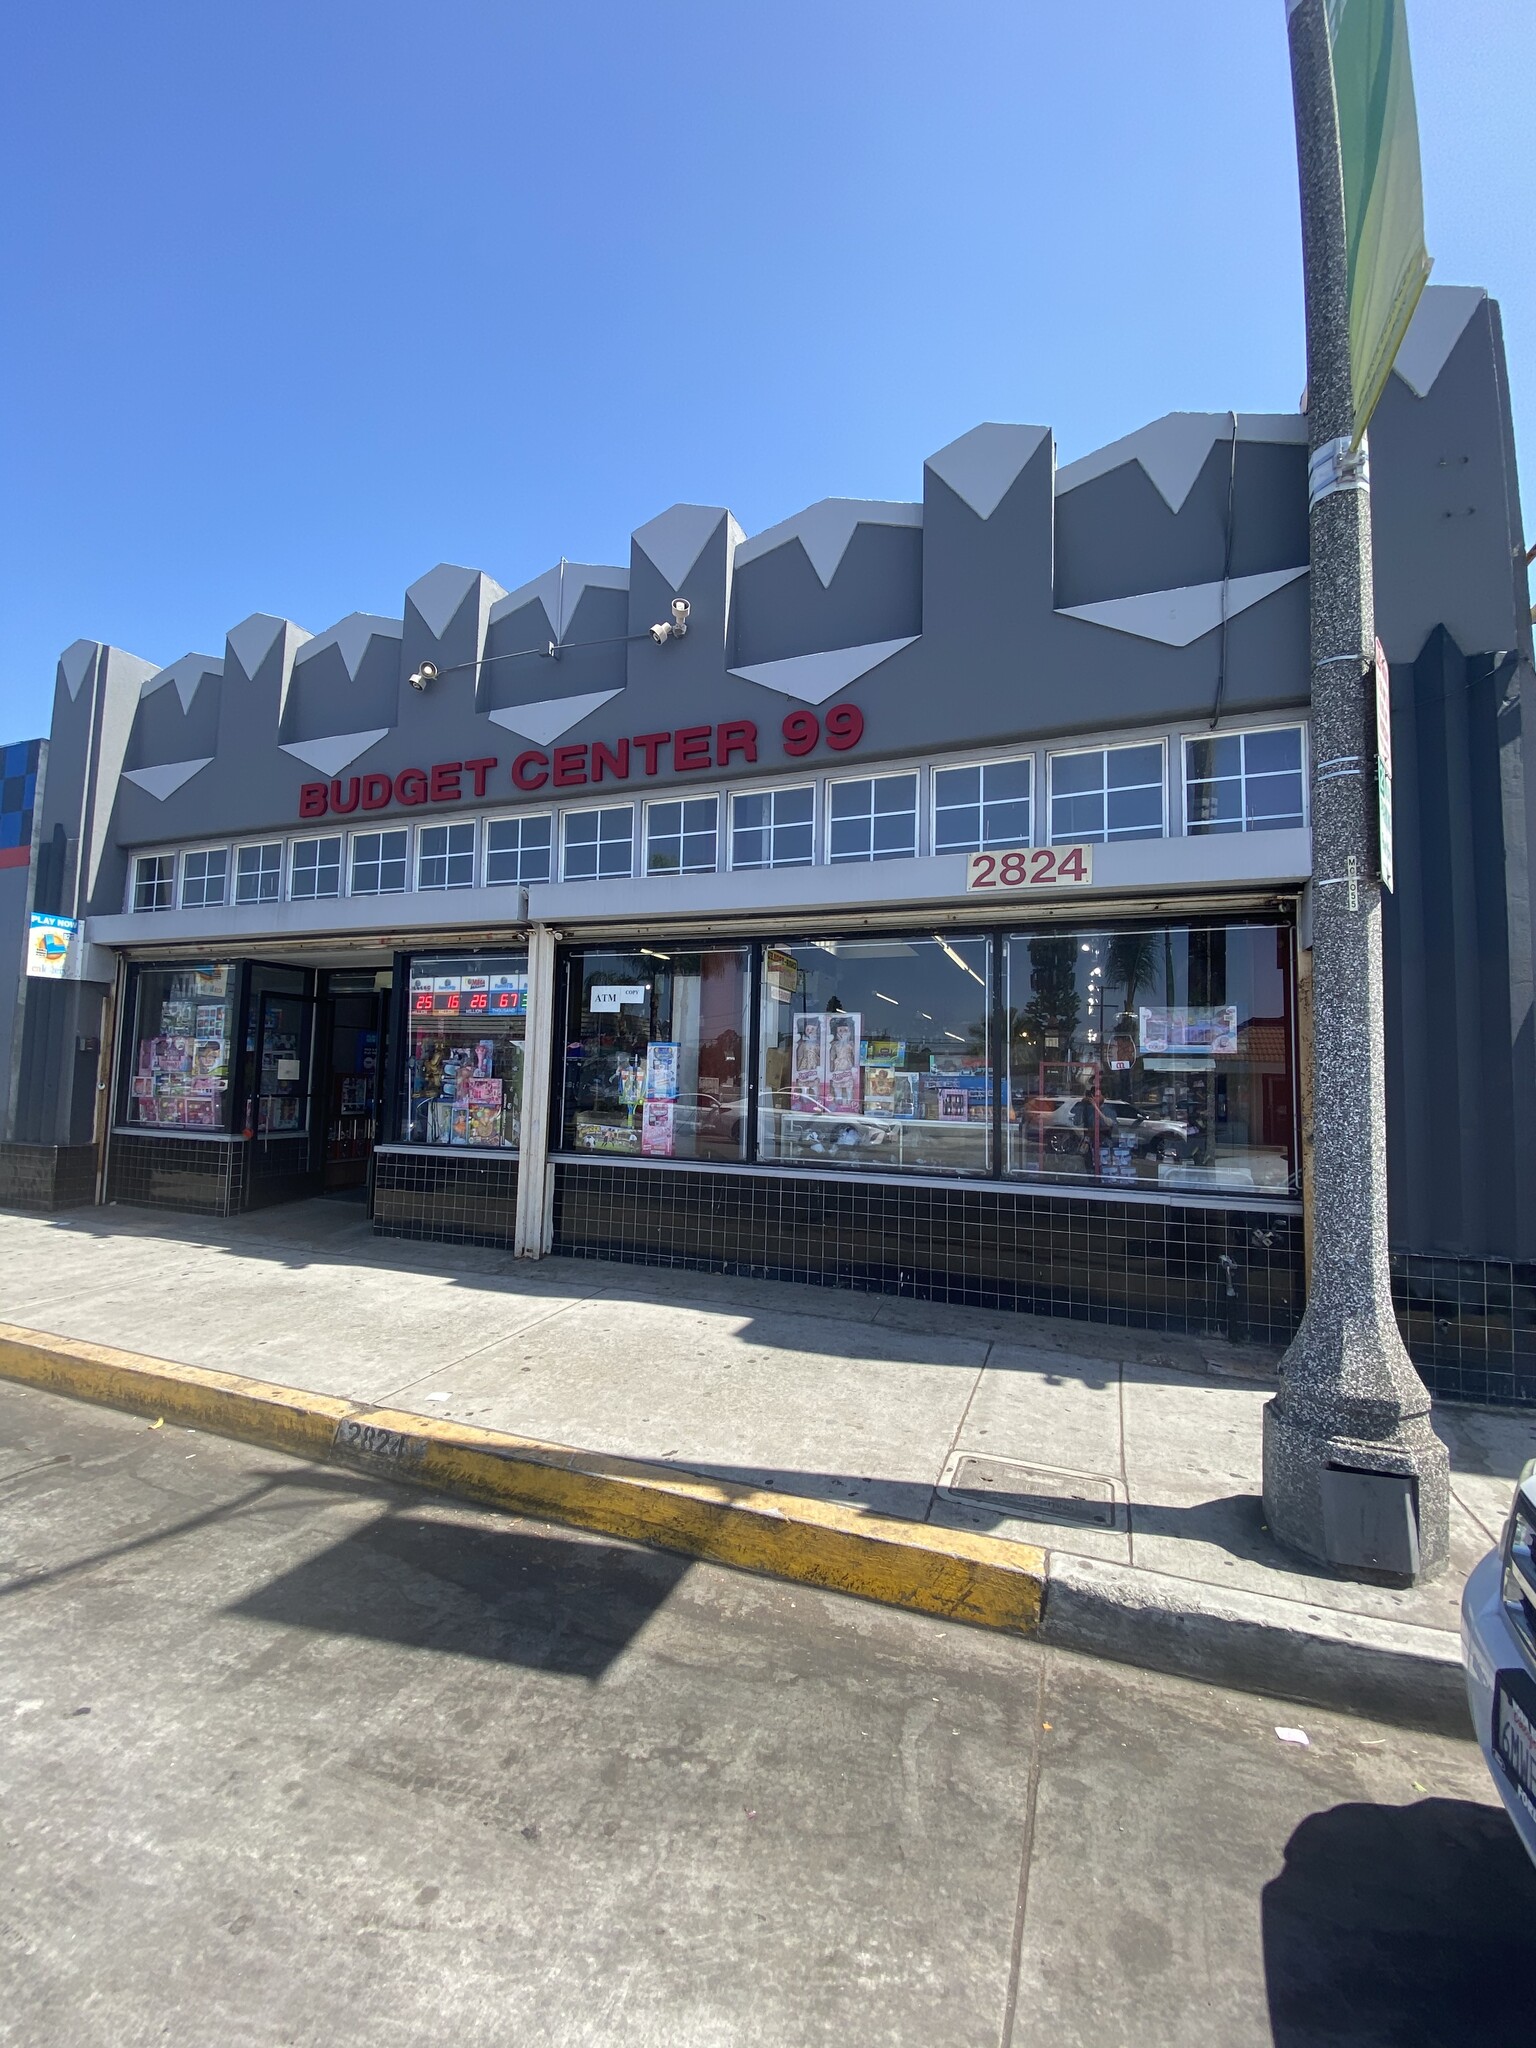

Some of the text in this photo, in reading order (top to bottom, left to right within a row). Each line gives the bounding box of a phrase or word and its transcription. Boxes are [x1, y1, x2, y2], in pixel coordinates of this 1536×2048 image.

[299, 703, 864, 819] BUDGET CENTER 99
[972, 848, 1088, 888] 2824
[31, 914, 78, 929] PLAY NOW
[416, 996, 433, 1009] 25
[447, 995, 460, 1008] 16
[470, 994, 488, 1008] 26
[499, 993, 518, 1008] 67
[594, 993, 617, 1002] ATM
[347, 1421, 405, 1457] 2824
